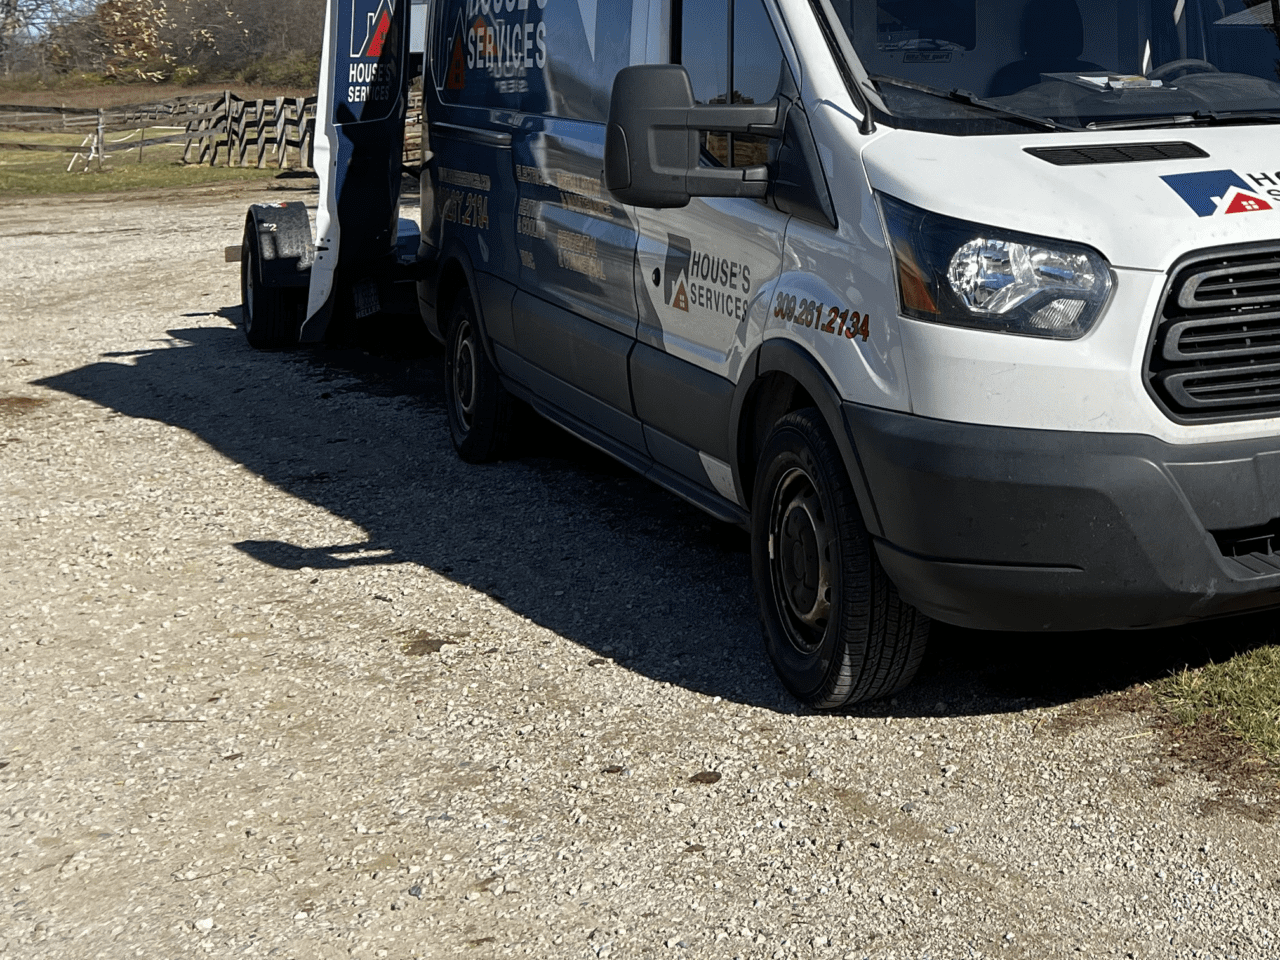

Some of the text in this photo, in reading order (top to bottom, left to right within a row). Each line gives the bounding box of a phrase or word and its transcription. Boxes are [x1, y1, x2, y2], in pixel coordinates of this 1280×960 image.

[467, 21, 547, 69] SERVICES
[691, 250, 751, 294] HOUSE'S
[690, 283, 748, 323] SERVICES
[774, 291, 870, 342] 309.261.2134
